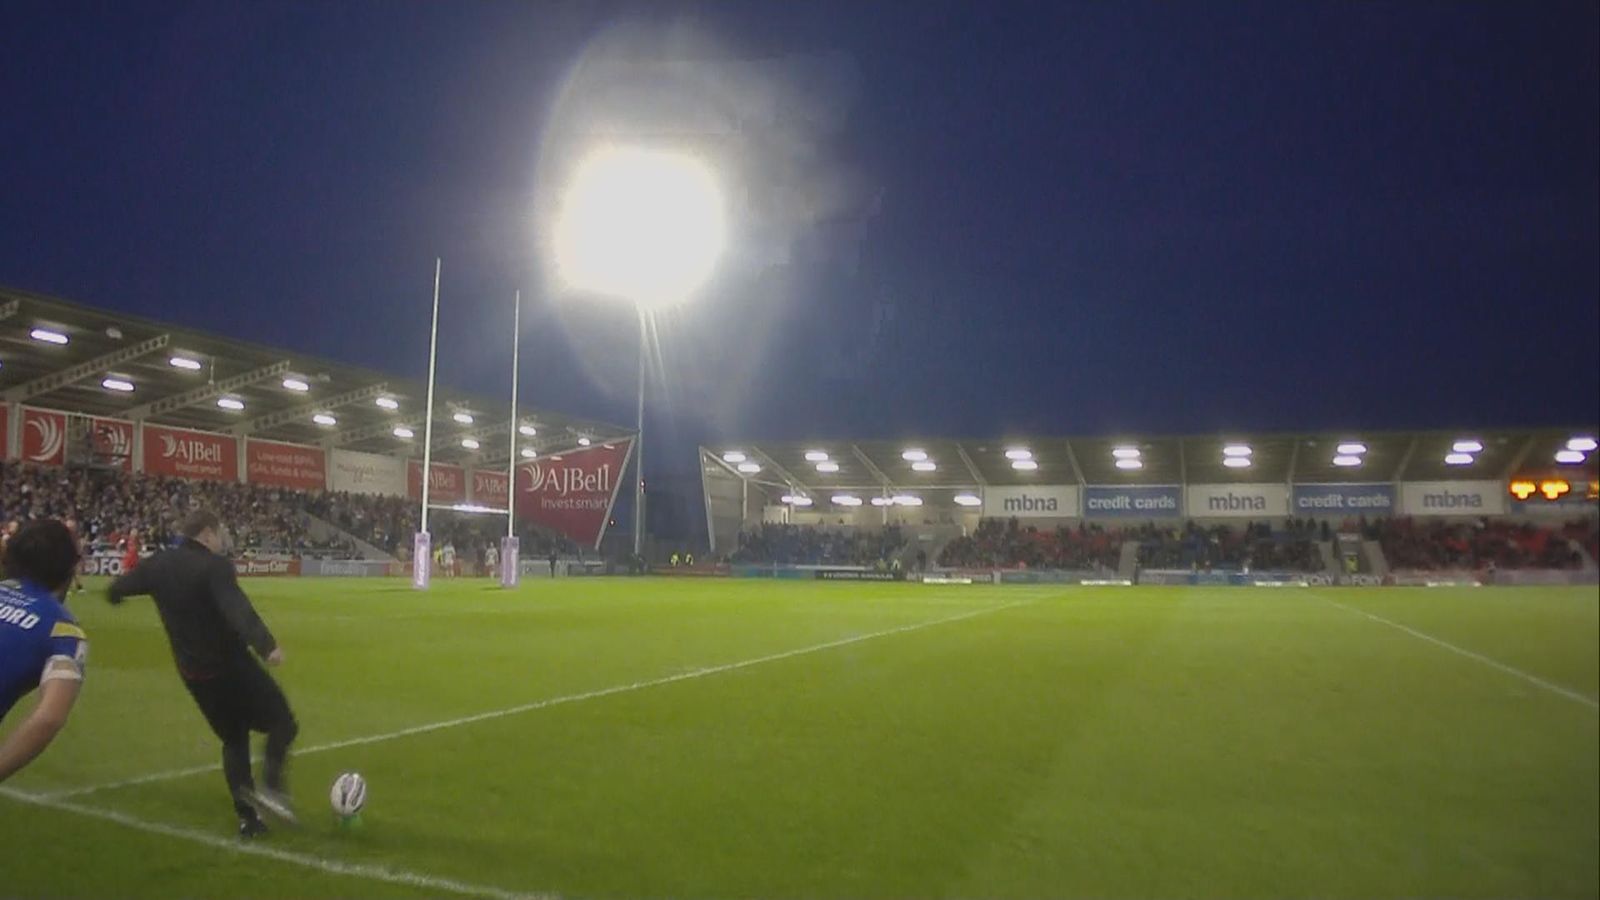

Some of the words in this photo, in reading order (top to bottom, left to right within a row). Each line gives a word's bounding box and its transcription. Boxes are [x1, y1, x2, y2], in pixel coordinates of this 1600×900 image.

[544, 464, 609, 496] AJBell
[1004, 494, 1058, 511] mbna
[1089, 496, 1132, 509] credit
[1135, 496, 1176, 509] cards
[1209, 493, 1266, 511] mbna
[1299, 493, 1342, 508] credit
[1348, 493, 1390, 508] cards
[1423, 490, 1482, 508] mbna
[0, 603, 41, 629] ORD
